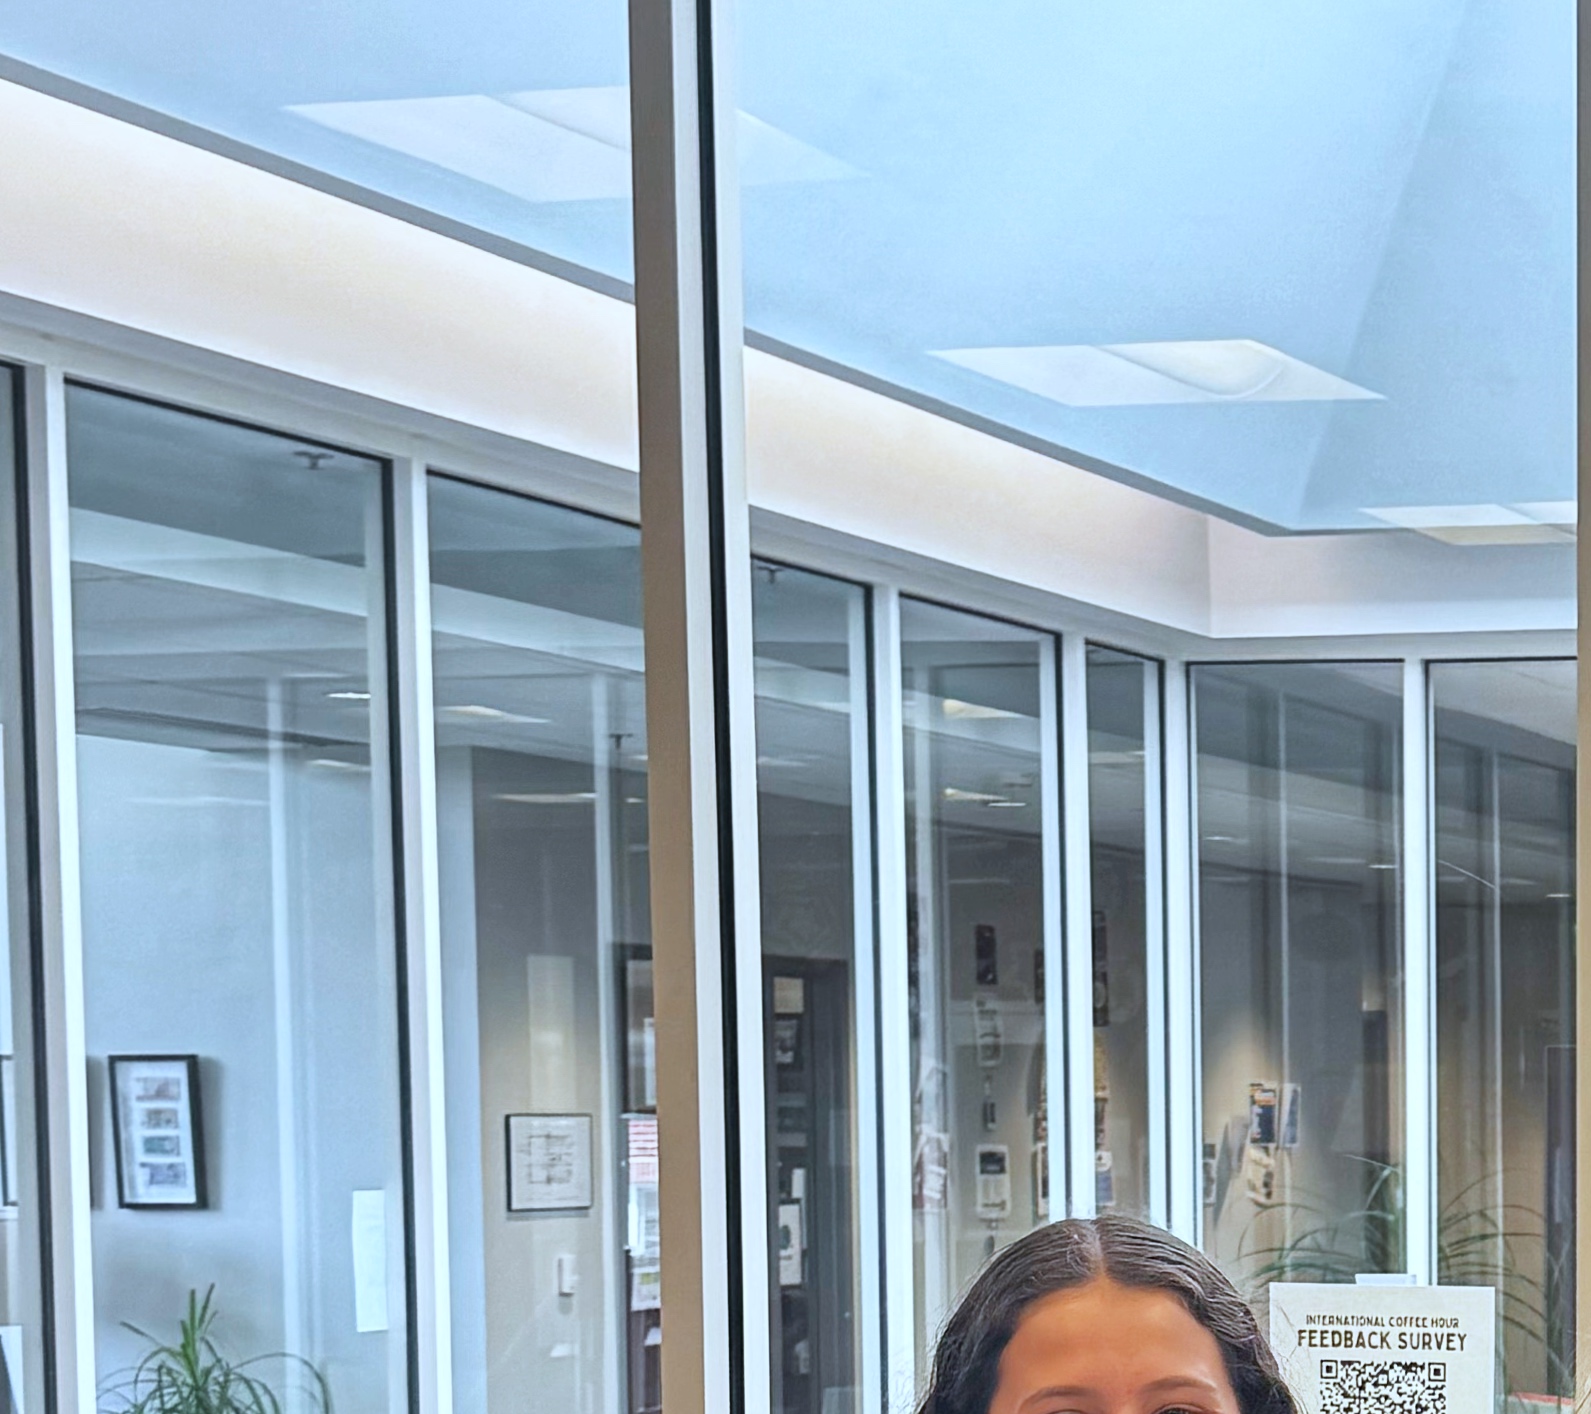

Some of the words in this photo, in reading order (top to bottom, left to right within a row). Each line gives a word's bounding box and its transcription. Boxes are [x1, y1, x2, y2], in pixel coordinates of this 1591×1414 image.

[1306, 1314, 1385, 1327] INTERNATIONAL
[1389, 1316, 1427, 1328] COFFEE
[1431, 1318, 1459, 1328] HOUR
[1297, 1329, 1392, 1350] FEEDBACK
[1398, 1332, 1467, 1351] SURVEY
